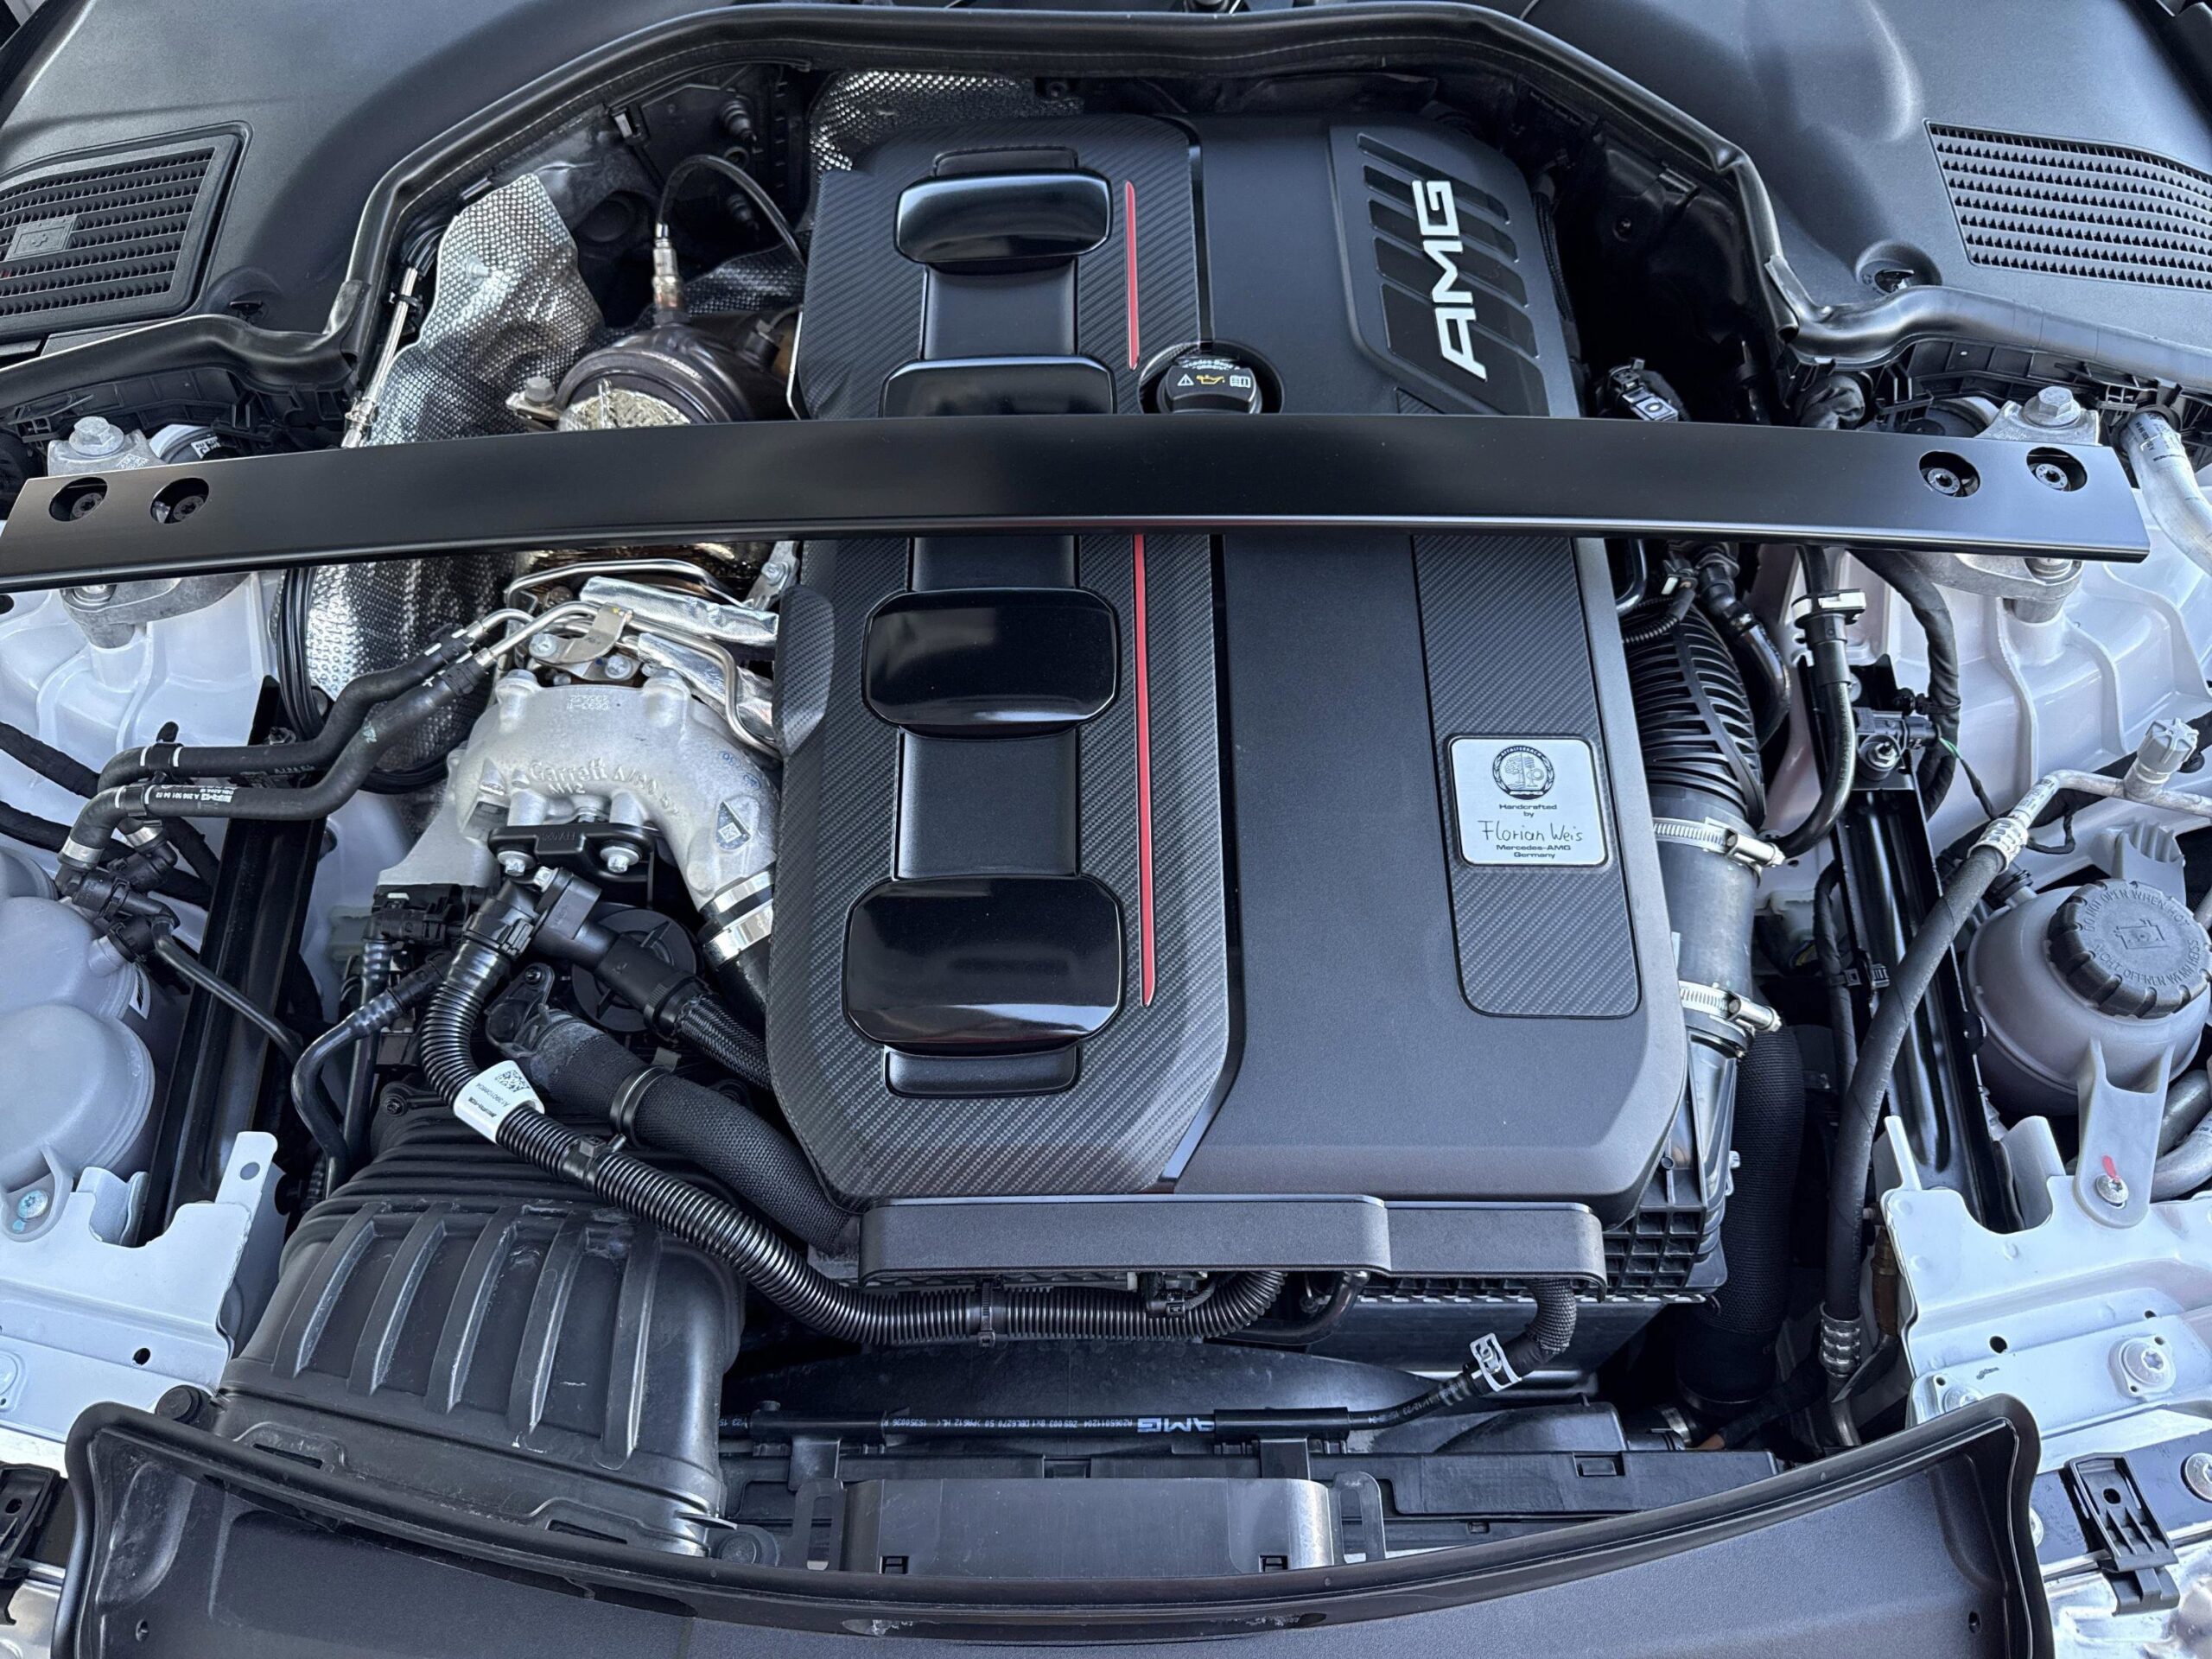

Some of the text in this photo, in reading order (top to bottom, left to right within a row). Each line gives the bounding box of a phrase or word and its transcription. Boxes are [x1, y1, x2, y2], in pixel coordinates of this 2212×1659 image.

[1412, 181, 1487, 382] AMG
[530, 757, 607, 782] Garrett
[1478, 820, 1583, 842] Florian Weis
[2101, 889, 2130, 904] OPEN
[2131, 889, 2167, 911] WHEN
[1137, 1417, 1215, 1433] AMG
